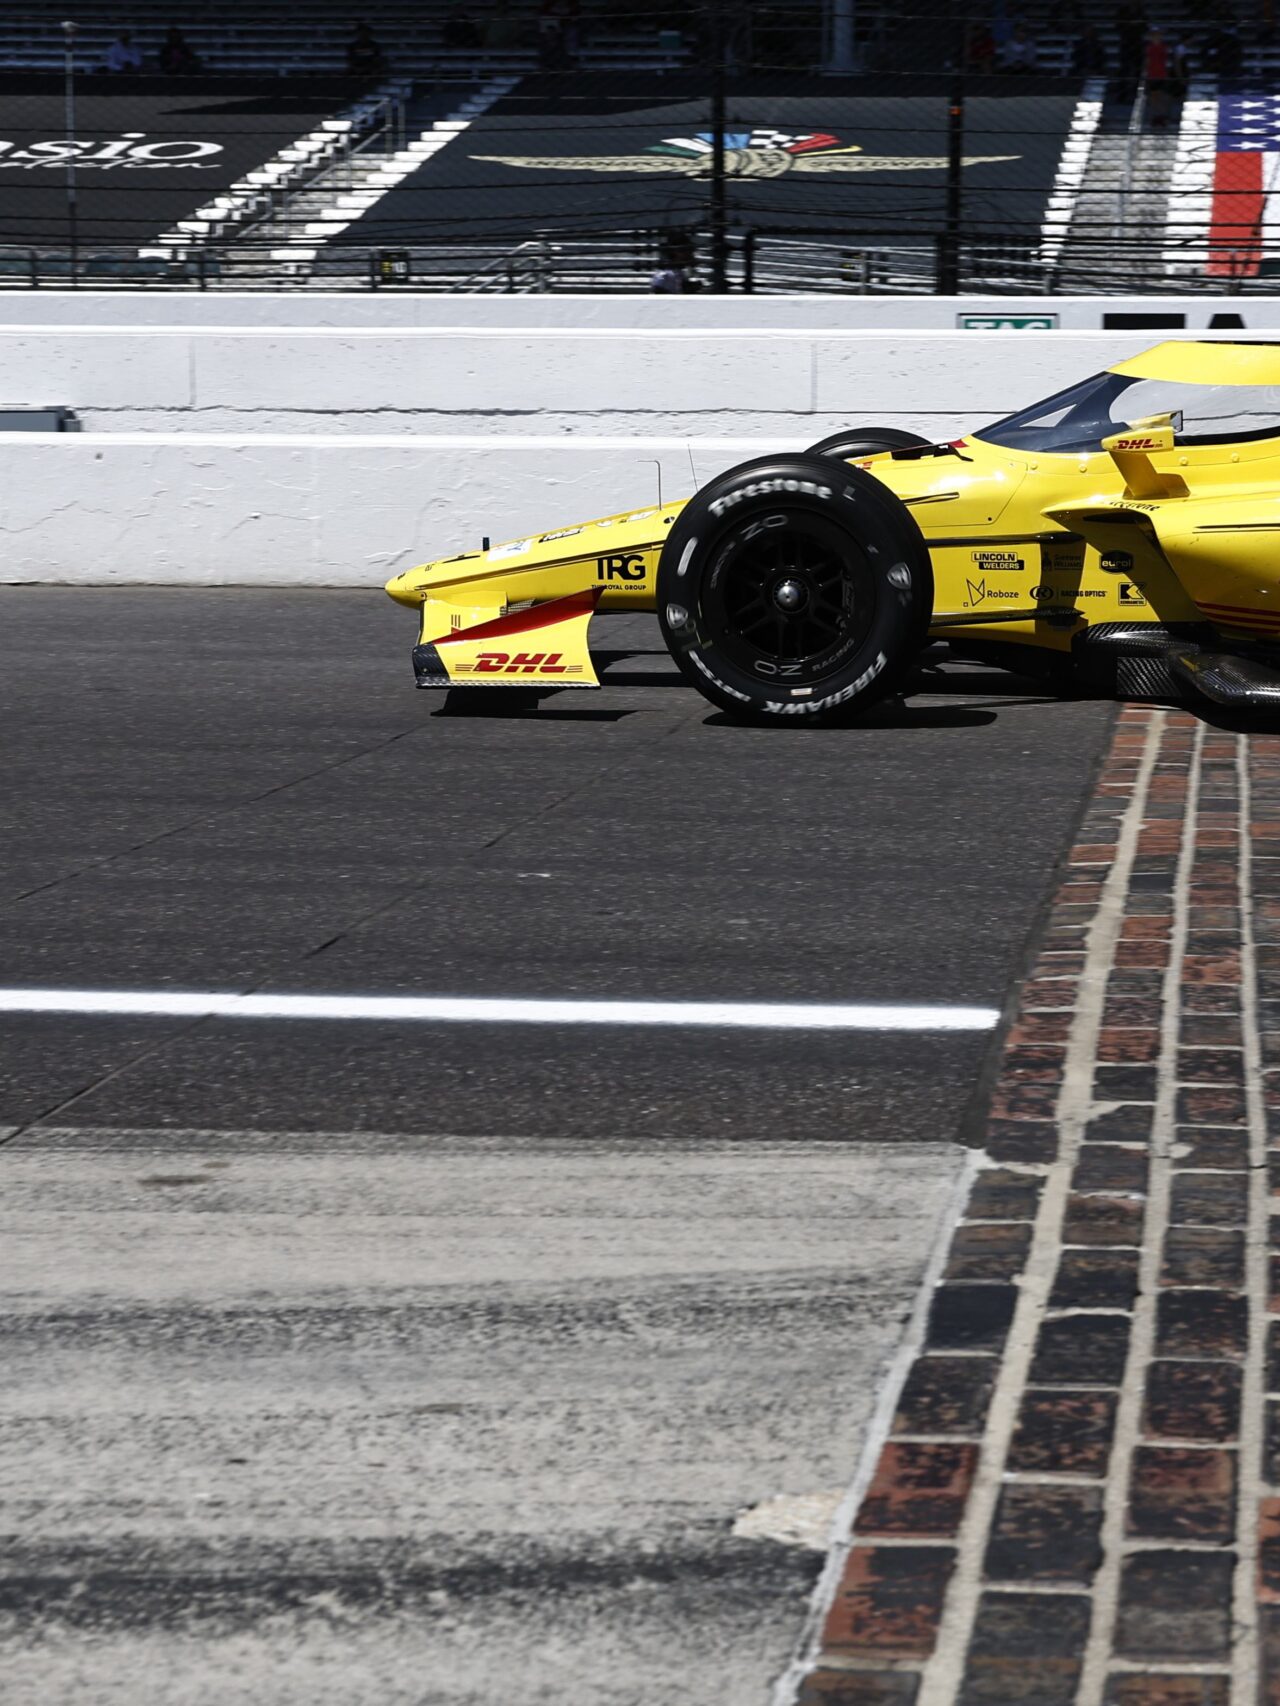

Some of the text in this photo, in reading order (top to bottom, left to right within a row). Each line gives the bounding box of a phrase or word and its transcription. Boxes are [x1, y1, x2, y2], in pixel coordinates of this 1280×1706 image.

[808, 160, 945, 168] SPEEDWAY
[1117, 439, 1154, 449] DHL
[708, 478, 832, 517] Firestone
[973, 553, 1016, 561] LINCOLN
[982, 562, 1020, 570] WELDERS
[1101, 559, 1131, 567] eurol
[987, 590, 1019, 598] Roboze
[473, 653, 569, 673] DHL
[762, 651, 888, 714] FIREHAWK
